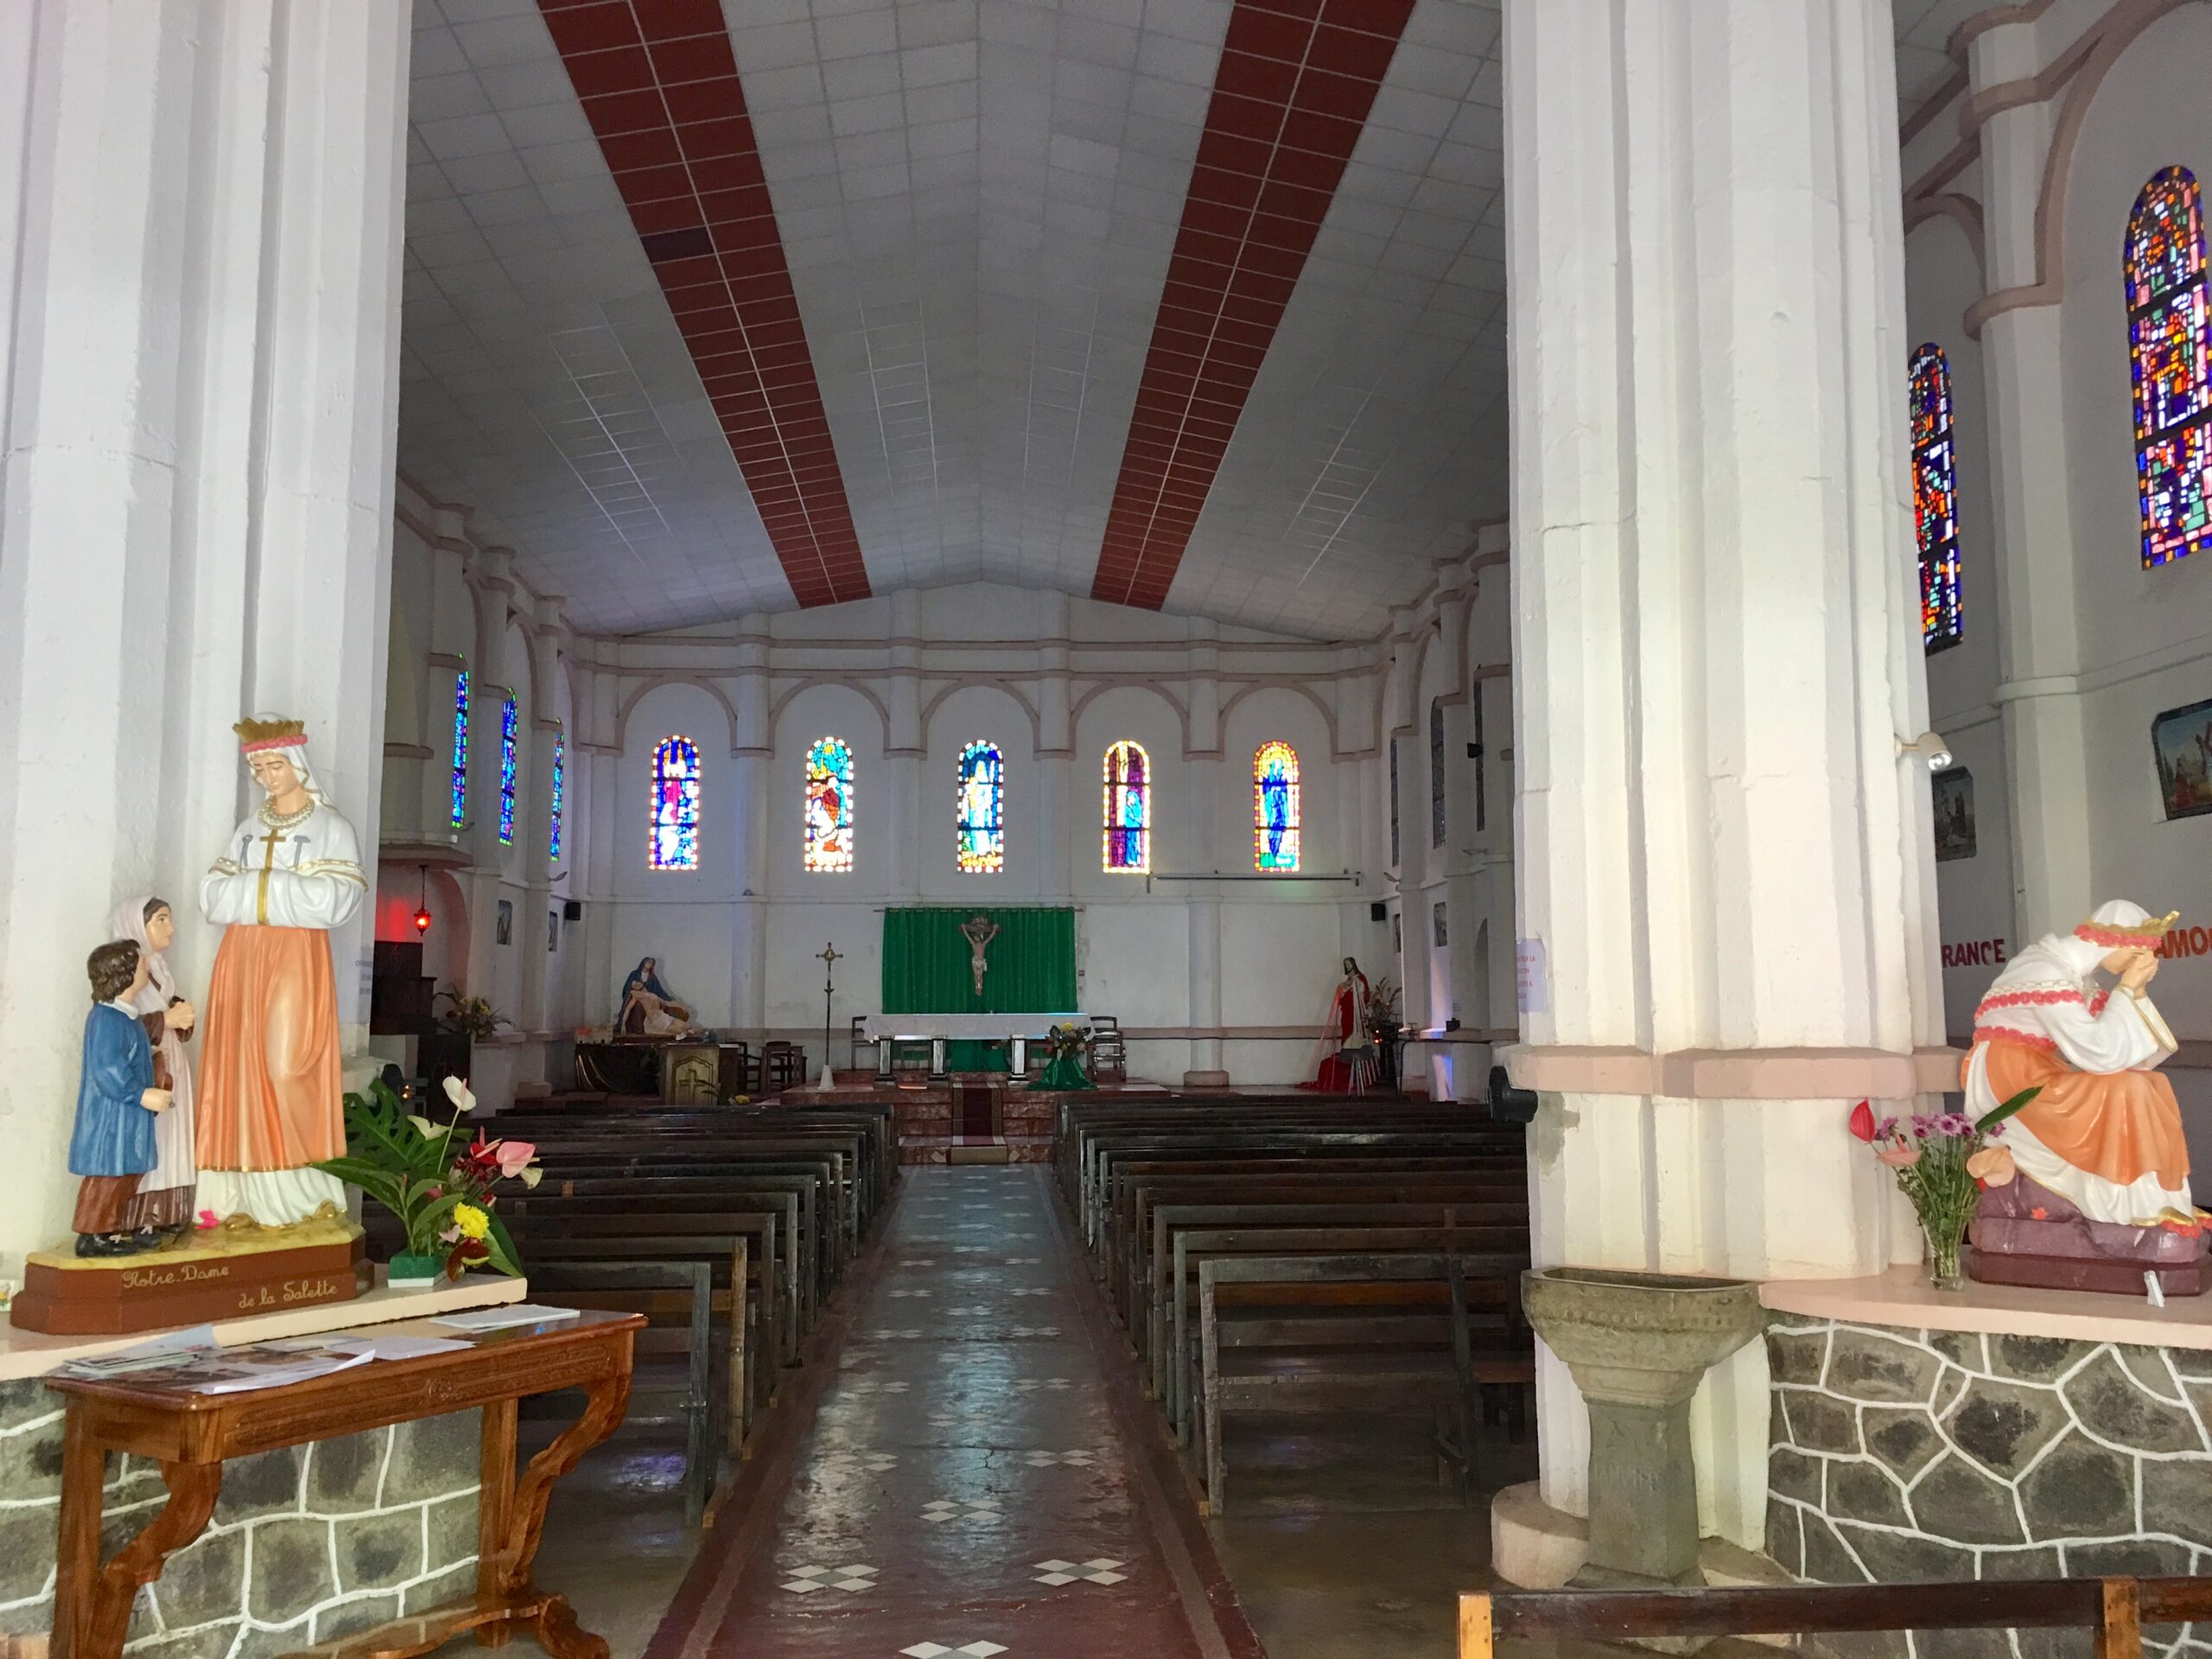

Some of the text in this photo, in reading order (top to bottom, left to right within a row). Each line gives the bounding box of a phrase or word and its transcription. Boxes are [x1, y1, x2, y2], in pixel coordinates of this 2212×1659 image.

[1942, 938, 2005, 968] RANCE
[2153, 925, 2212, 959] AMO
[181, 1265, 229, 1281] Dame
[238, 1280, 338, 1308] de la Salette
